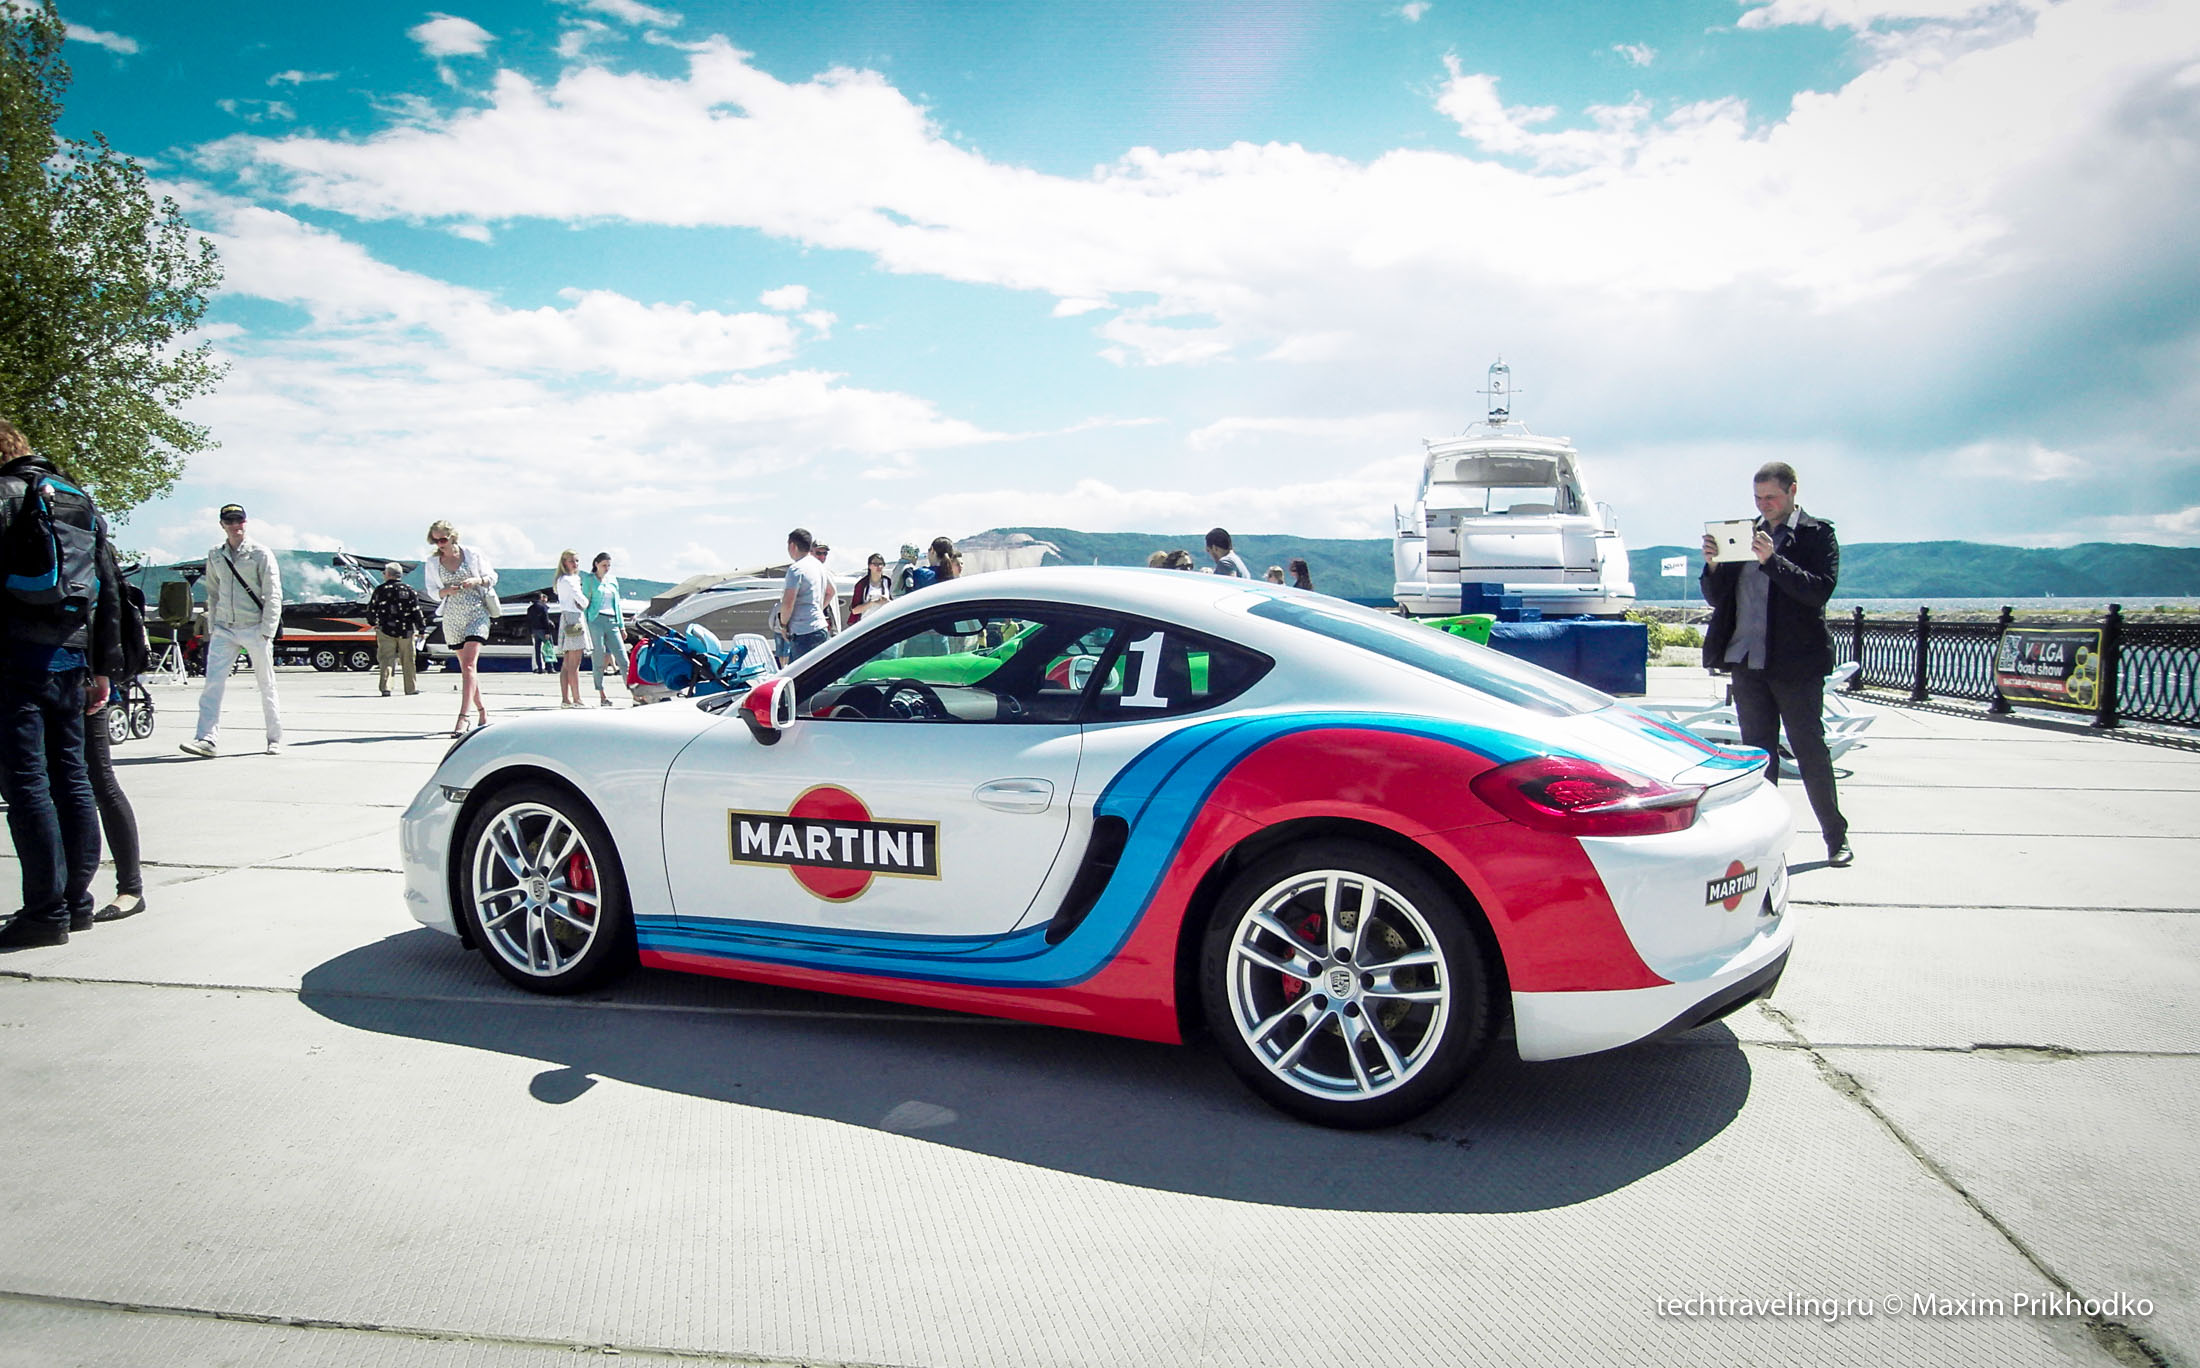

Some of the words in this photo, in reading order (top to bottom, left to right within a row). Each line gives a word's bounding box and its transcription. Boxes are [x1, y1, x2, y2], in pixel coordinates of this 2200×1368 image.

[1120, 631, 1168, 708] 1
[2017, 661, 2036, 675] boat
[2037, 663, 2064, 677] show
[740, 820, 925, 868] MARTINI
[1709, 871, 1756, 901] MARTINI
